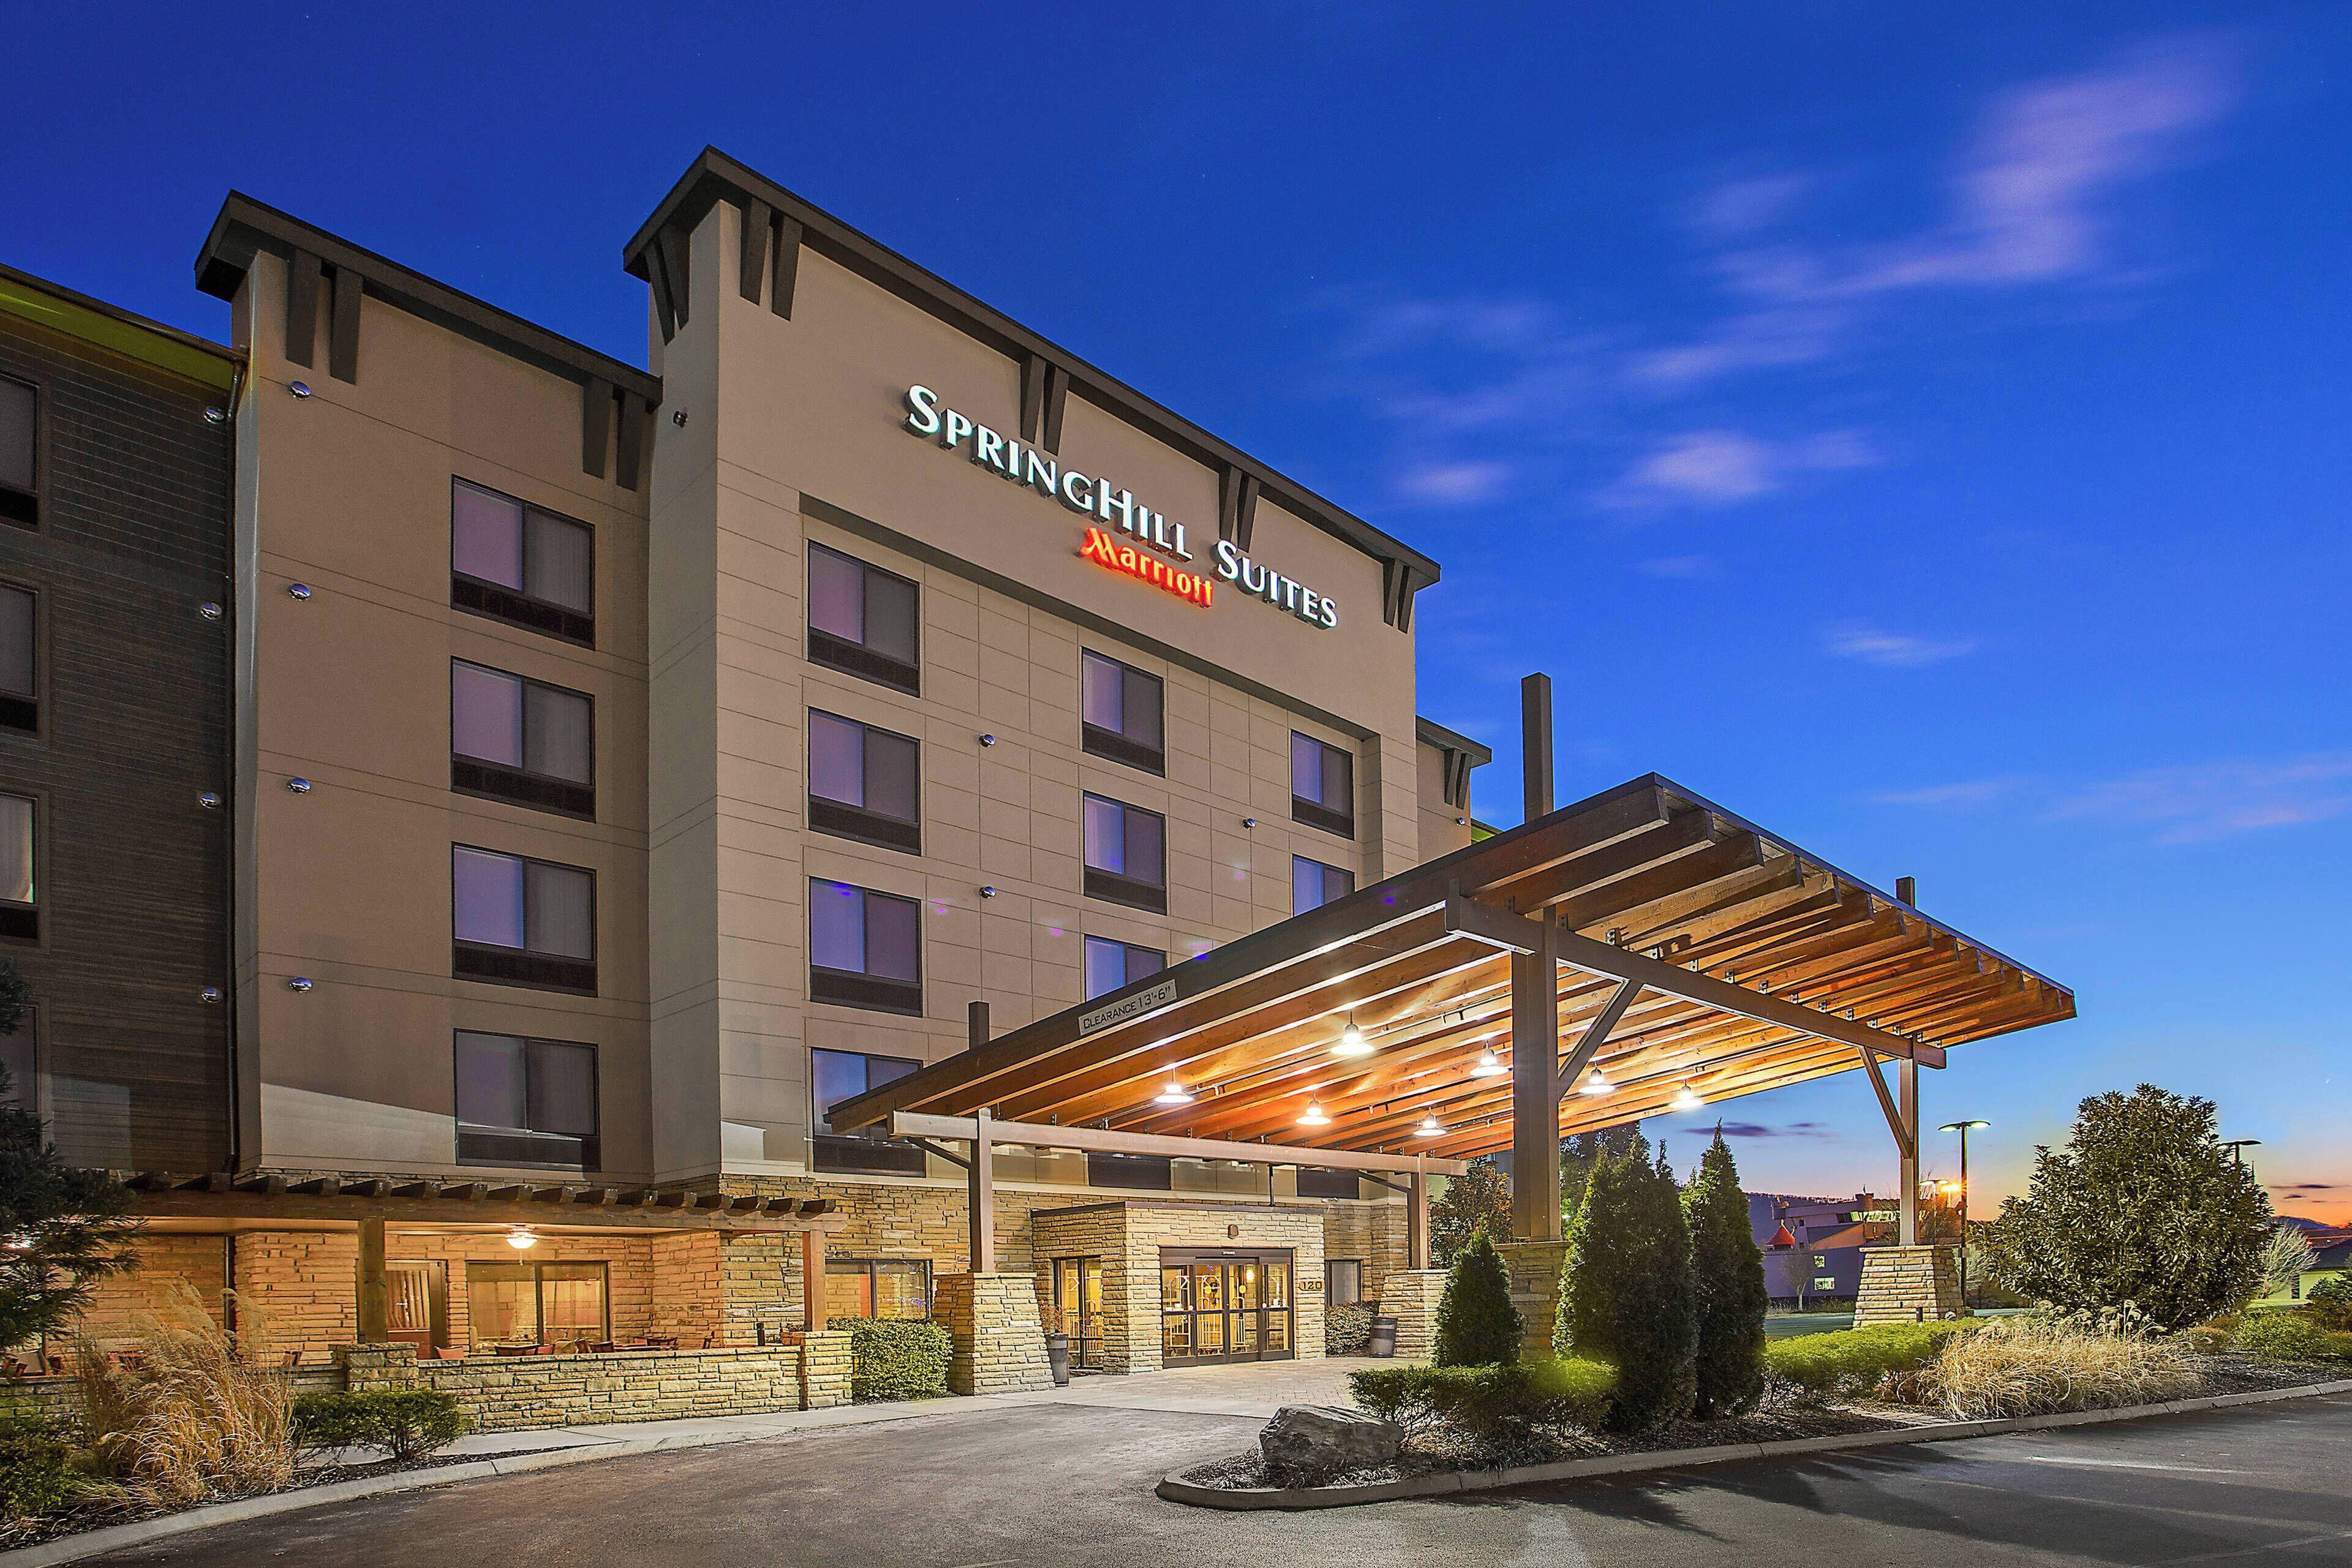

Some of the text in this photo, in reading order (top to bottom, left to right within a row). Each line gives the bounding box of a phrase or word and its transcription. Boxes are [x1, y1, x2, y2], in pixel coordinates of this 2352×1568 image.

[907, 383, 1338, 628] SPRINGHILL SUITES
[1081, 527, 1213, 607] Marriott
[1083, 1001, 1137, 1030] CLEARANCE
